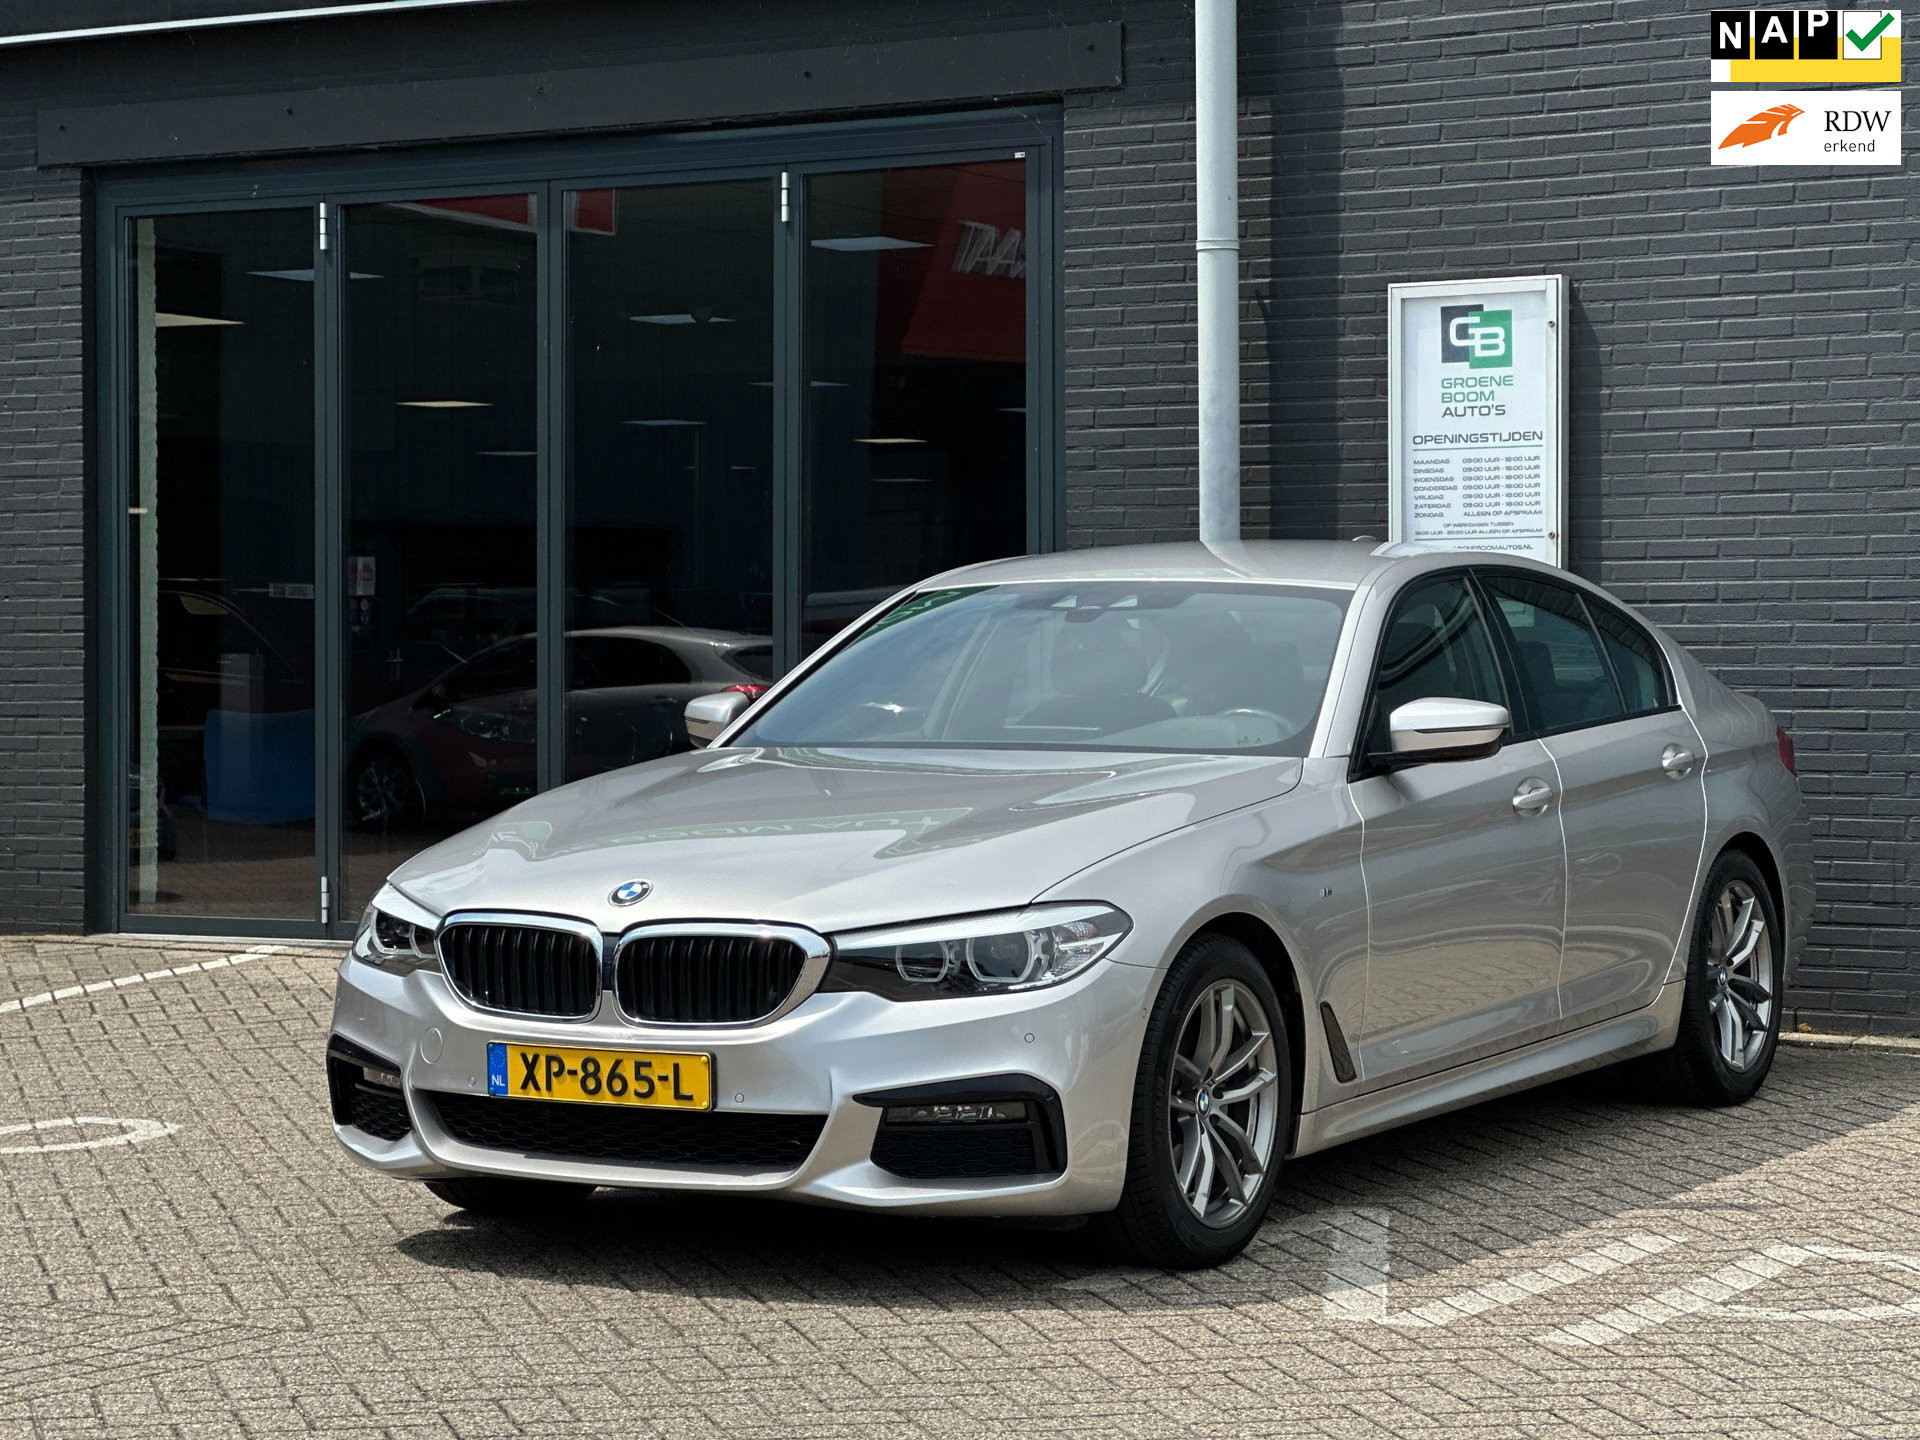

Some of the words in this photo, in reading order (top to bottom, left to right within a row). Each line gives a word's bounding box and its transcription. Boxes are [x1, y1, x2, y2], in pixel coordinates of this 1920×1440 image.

[1441, 375, 1514, 389] GROENE
[1441, 391, 1494, 403] BOOM
[1442, 404, 1506, 418] AUTO'S
[1412, 431, 1543, 445] OPENINGSTIJDEN
[491, 1074, 506, 1087] NL
[520, 1052, 694, 1101] XP-865-L
